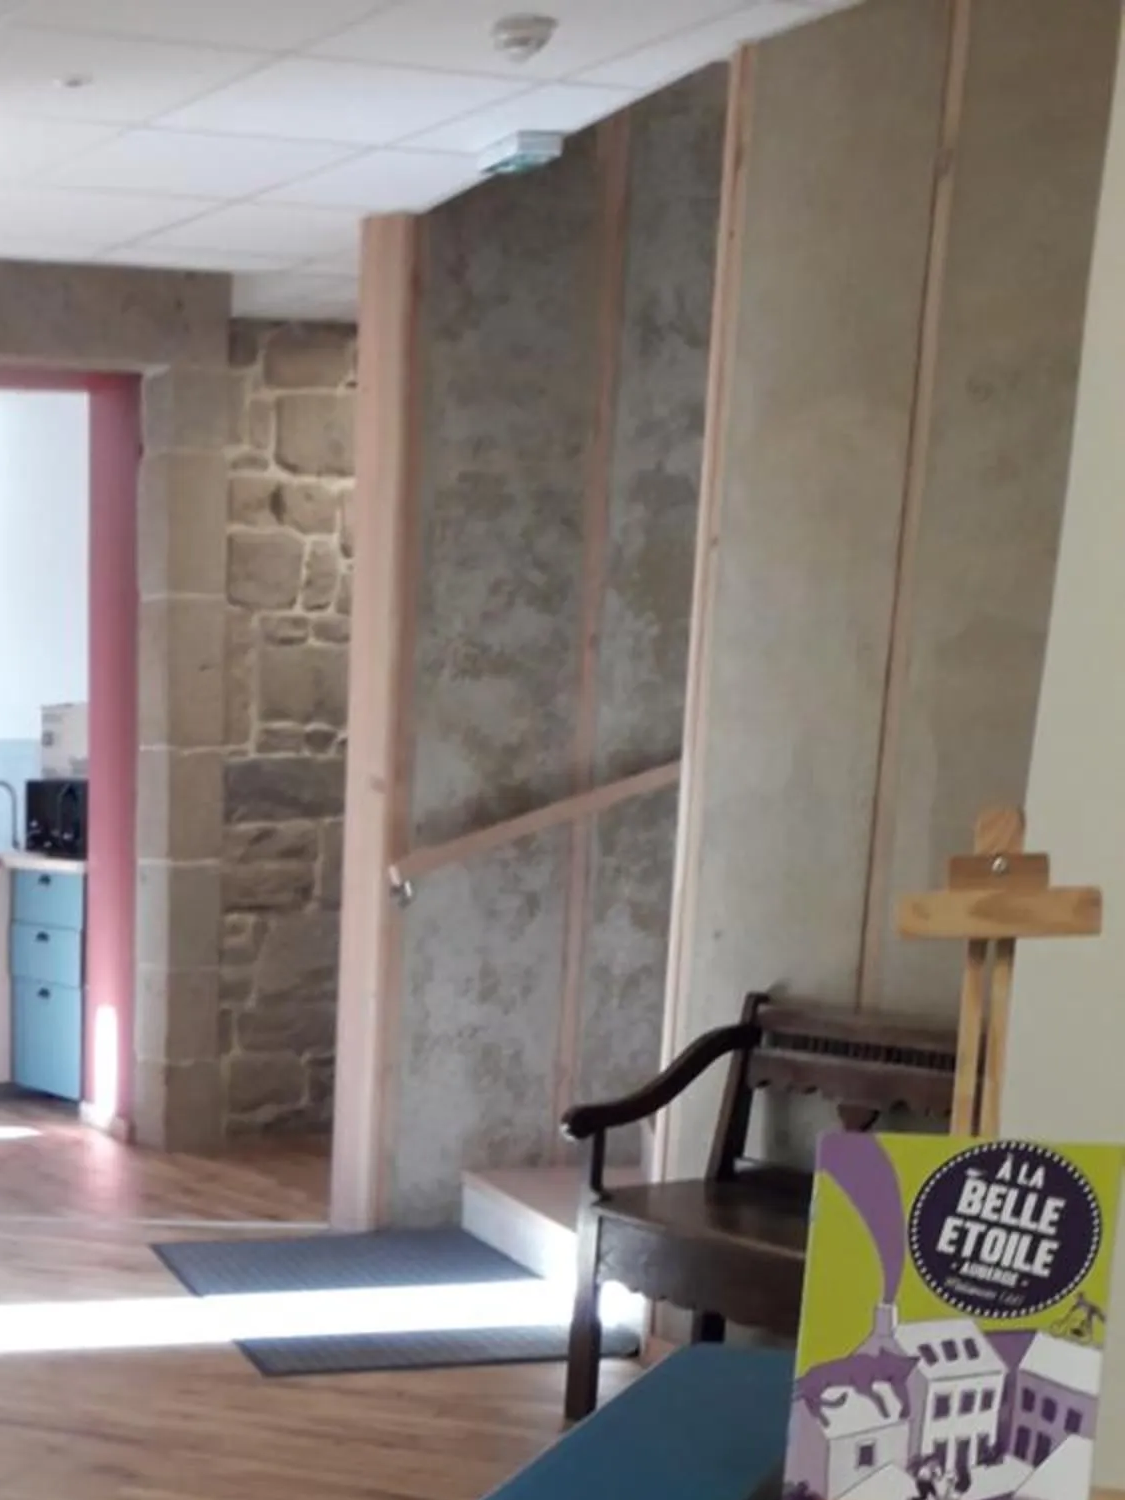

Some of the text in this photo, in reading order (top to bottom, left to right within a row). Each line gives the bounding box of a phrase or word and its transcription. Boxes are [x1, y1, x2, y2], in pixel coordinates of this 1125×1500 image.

[1017, 1162, 1045, 1189] LA
[956, 1177, 1066, 1236] BELLE
[936, 1216, 1060, 1278] ETOILE
